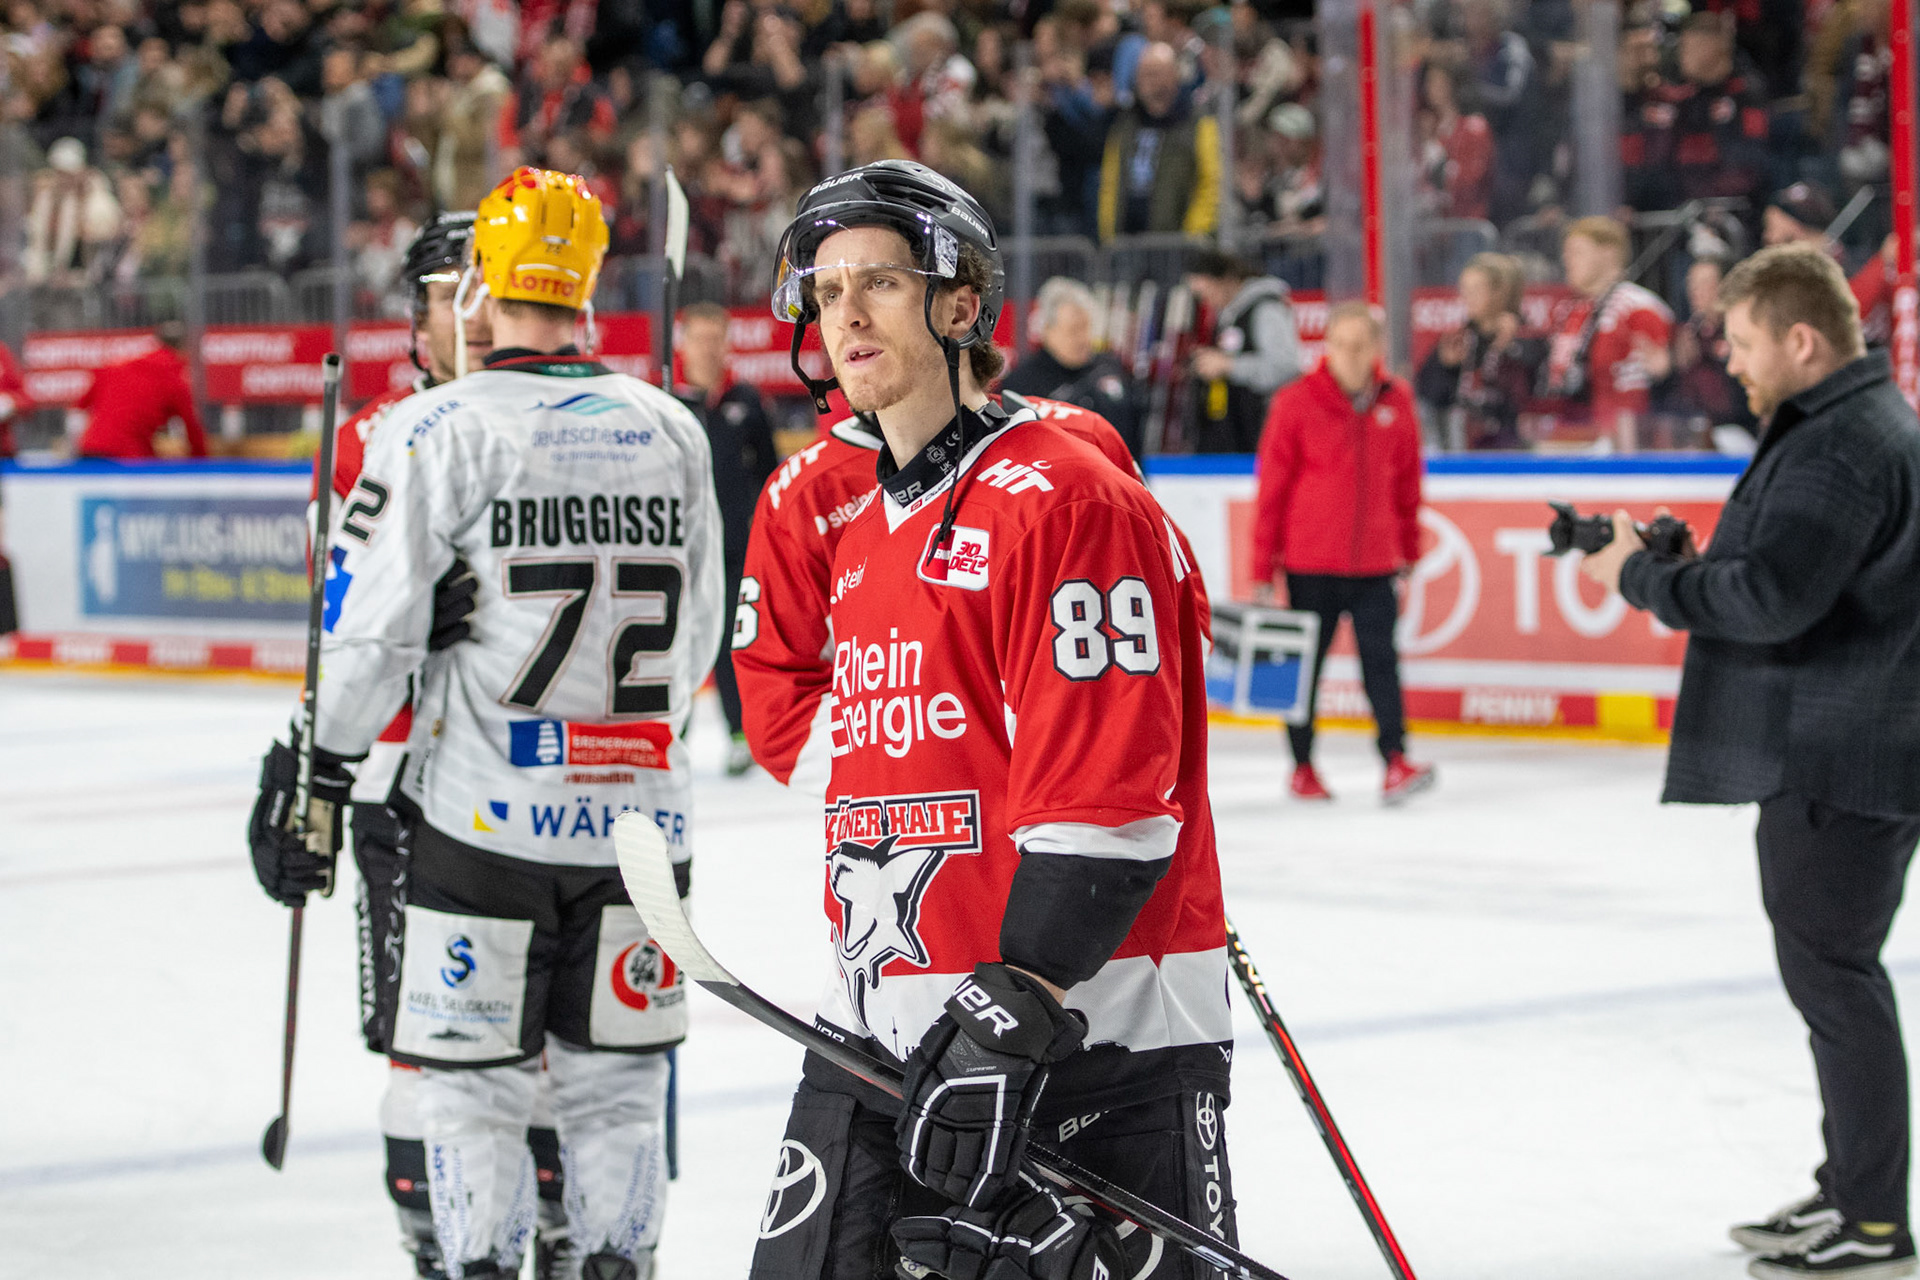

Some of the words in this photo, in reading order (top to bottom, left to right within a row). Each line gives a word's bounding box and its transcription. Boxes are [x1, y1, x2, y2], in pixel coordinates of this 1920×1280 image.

[809, 173, 864, 196] BAUER
[951, 206, 989, 239] BAUER
[510, 272, 575, 297] LOTTO
[976, 458, 1054, 495] HIT
[957, 541, 982, 557] 30
[500, 556, 686, 718] 72
[1050, 575, 1161, 682] 89
[832, 627, 923, 698] Rhein
[831, 692, 967, 758] Energie
[532, 796, 686, 845] WÄHER
[826, 804, 882, 853] KÖNER
[887, 801, 972, 842] HAIE
